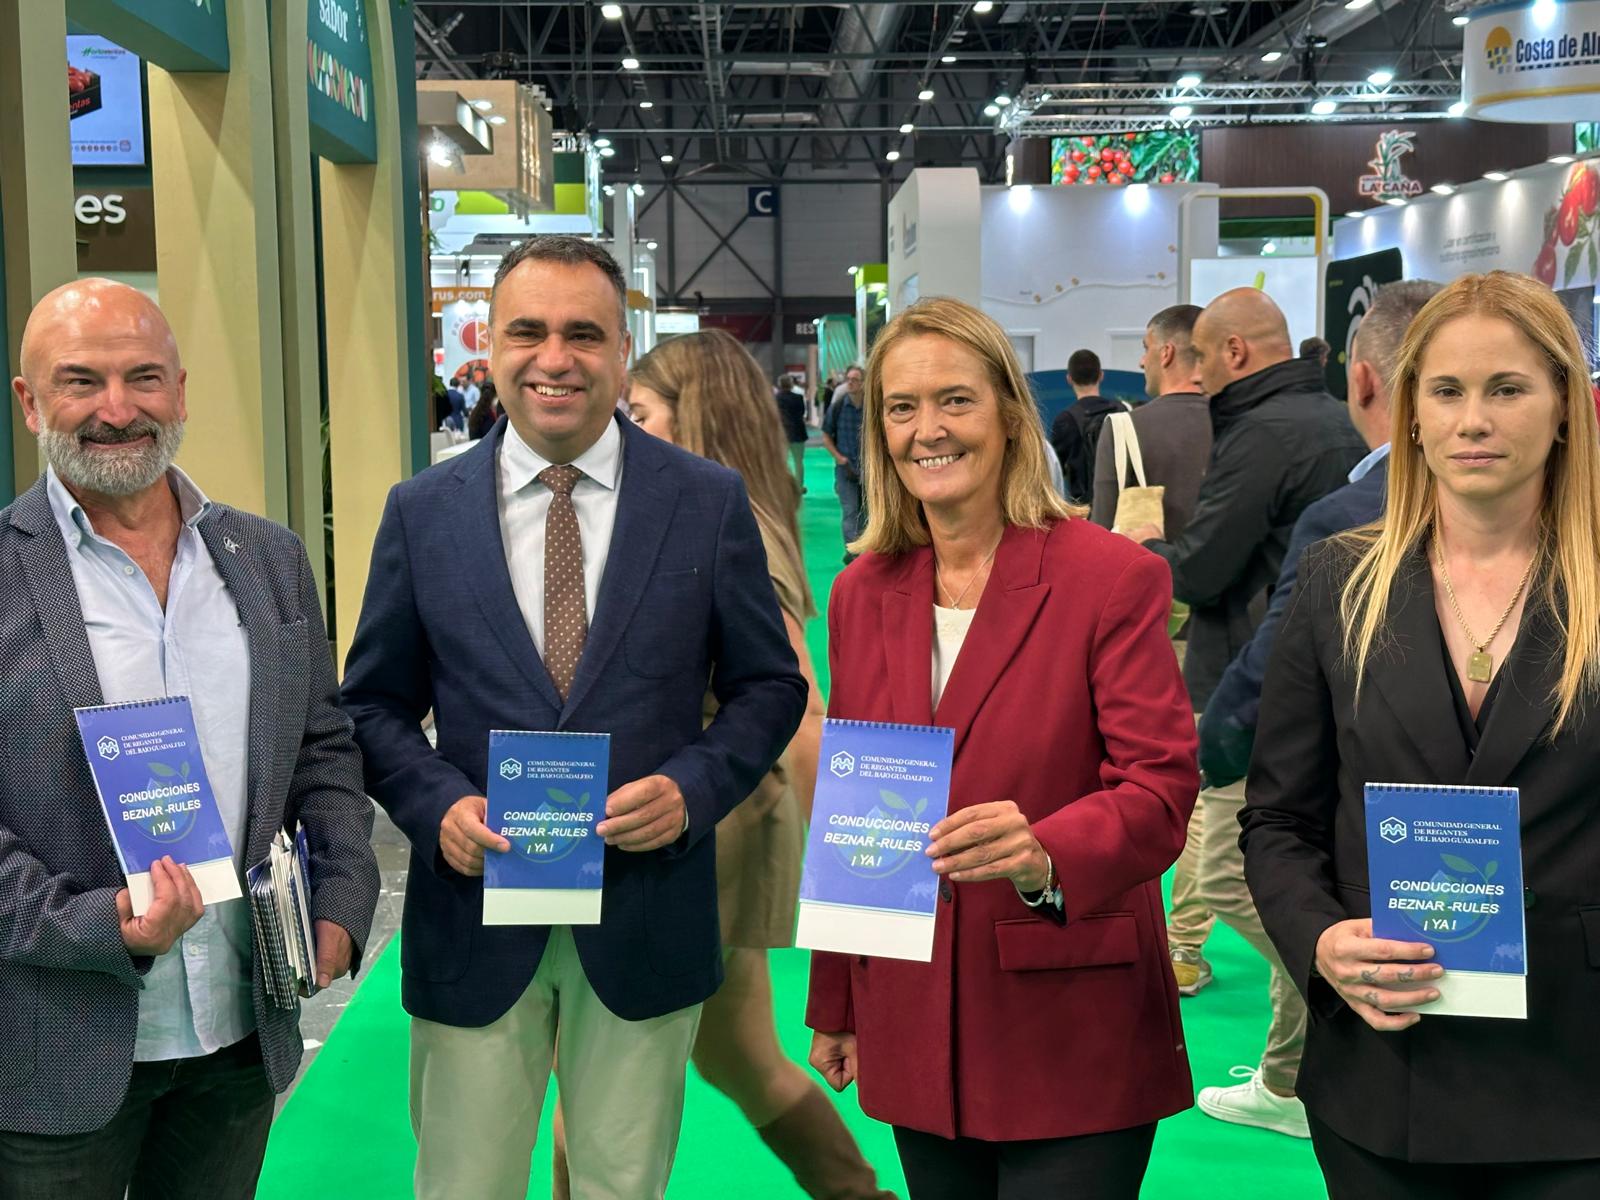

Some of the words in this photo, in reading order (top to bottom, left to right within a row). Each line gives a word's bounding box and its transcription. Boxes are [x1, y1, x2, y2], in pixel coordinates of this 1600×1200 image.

[1516, 38, 1554, 63] Costa
[1558, 34, 1578, 58] de
[1581, 32, 1600, 56] Al
[1362, 182, 1377, 192] LA
[75, 194, 126, 224] es
[754, 191, 772, 213] C
[861, 756, 904, 765] COMUNIDAD
[904, 760, 938, 768] GENERAL
[871, 764, 907, 773] REGANTES
[119, 782, 200, 804] CONDUCCIONES
[122, 805, 163, 821] BEZNAR
[503, 811, 594, 822] CONDUCCIONES
[500, 827, 545, 836] BEZNAR
[829, 814, 930, 834] CONDUCCIONES
[824, 832, 875, 847] BEZNAR
[1451, 837, 1500, 845] GUADALFEO
[1390, 880, 1504, 896] CONDUCCIONES
[1388, 897, 1445, 911] BEZNAR
